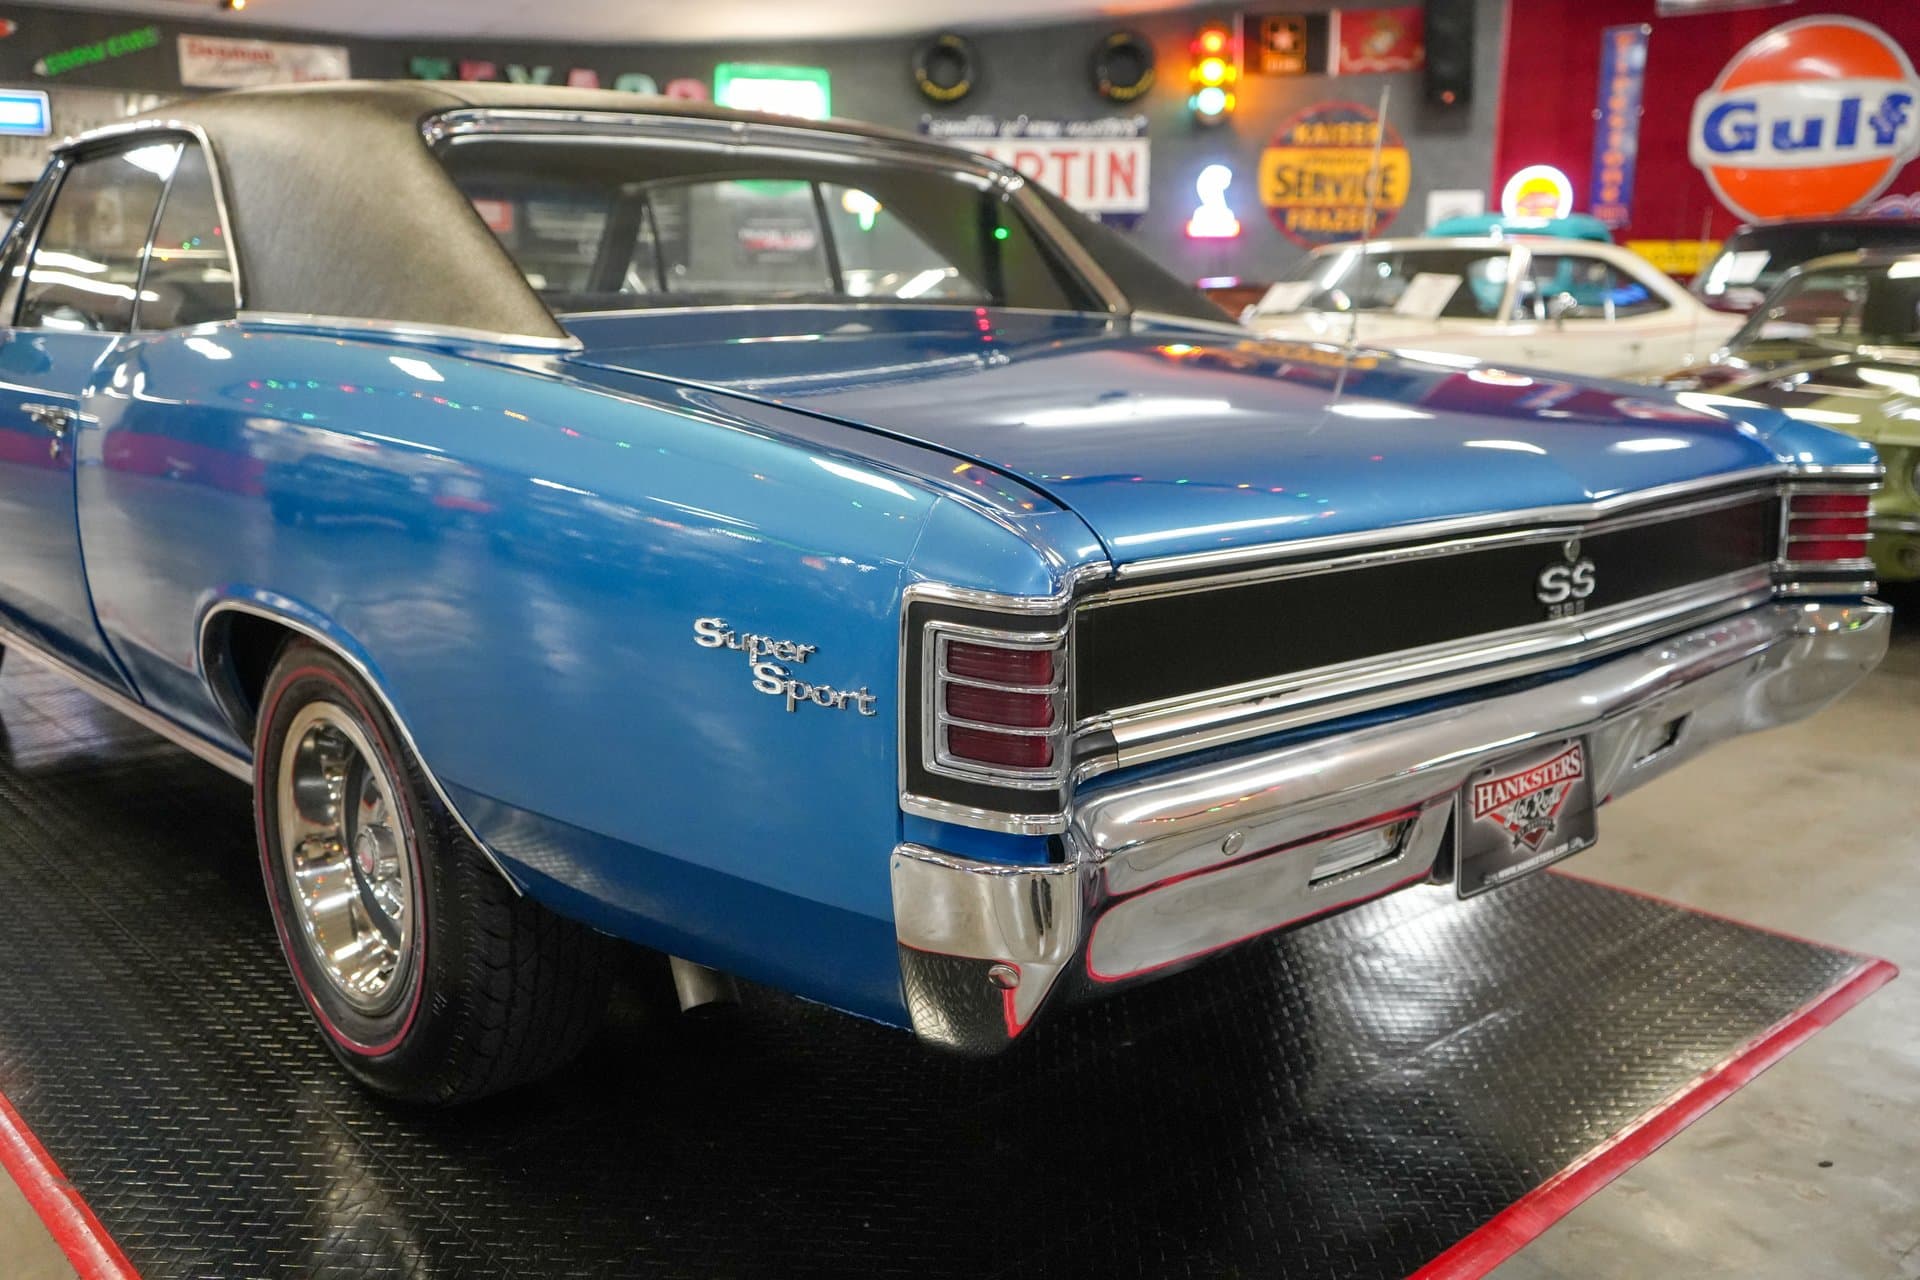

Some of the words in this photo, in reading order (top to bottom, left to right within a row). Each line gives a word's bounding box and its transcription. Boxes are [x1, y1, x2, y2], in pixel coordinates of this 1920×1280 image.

[1702, 93, 1912, 154] Gulf
[1274, 162, 1398, 200] SERVICE
[1537, 561, 1596, 604] SS
[693, 617, 816, 666] Super
[752, 662, 877, 716] Sport
[1476, 748, 1582, 815] HANKSTERS
